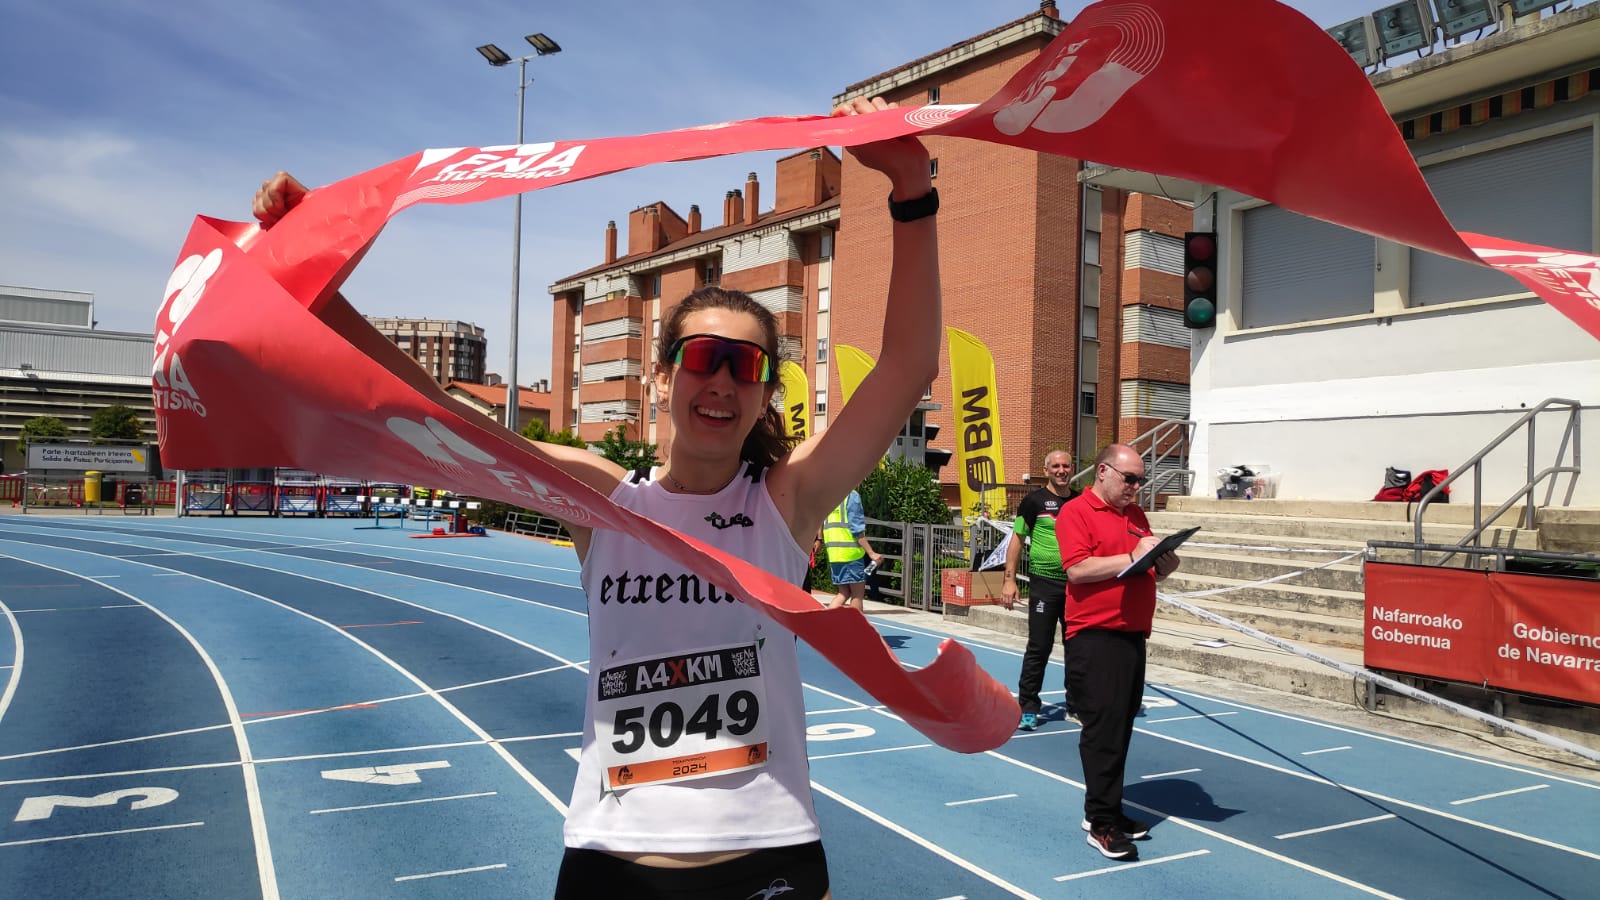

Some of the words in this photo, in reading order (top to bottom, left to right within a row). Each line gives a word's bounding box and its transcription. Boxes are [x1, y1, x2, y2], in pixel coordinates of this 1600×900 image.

[1372, 606, 1463, 631] Nafarroako
[1371, 626, 1451, 650] Gobernua
[1498, 644, 1521, 660] de
[636, 654, 723, 691] A4XKM
[612, 690, 760, 754] 5049
[321, 760, 451, 785] 4
[673, 762, 707, 776] 2024
[14, 787, 180, 822] 3
